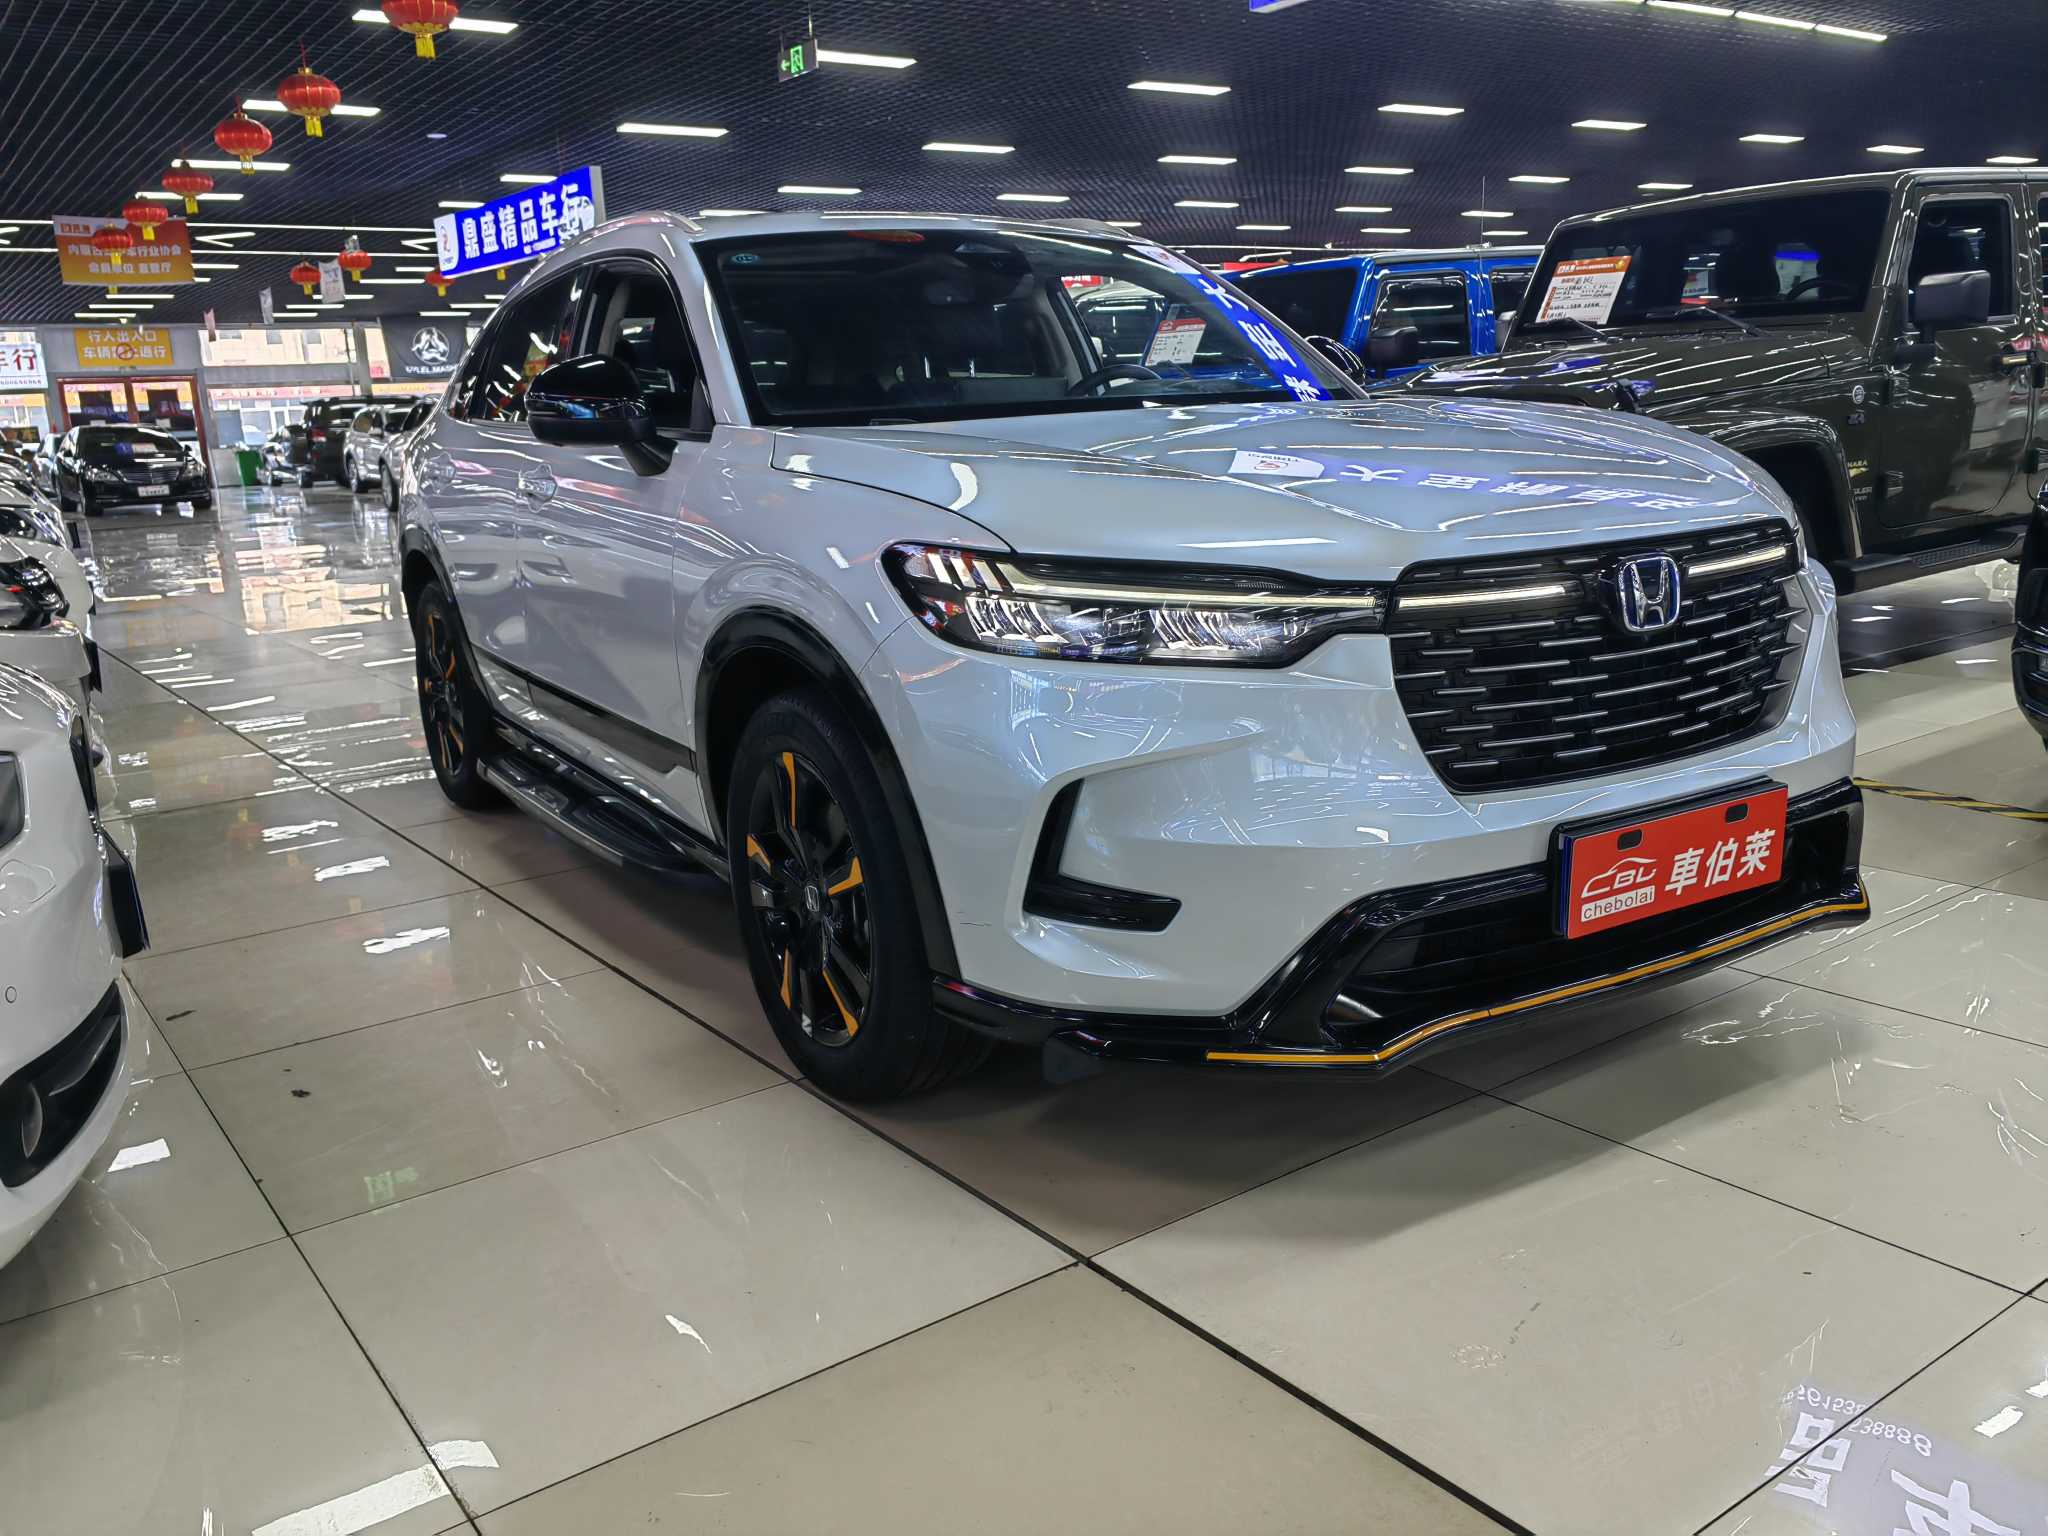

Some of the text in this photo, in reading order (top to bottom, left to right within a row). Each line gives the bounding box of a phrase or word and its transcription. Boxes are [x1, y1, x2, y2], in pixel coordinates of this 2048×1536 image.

[88, 330, 157, 343] 行人出入口
[1664, 828, 1776, 896] 車伯莱
[1583, 886, 1654, 920] chebolai
